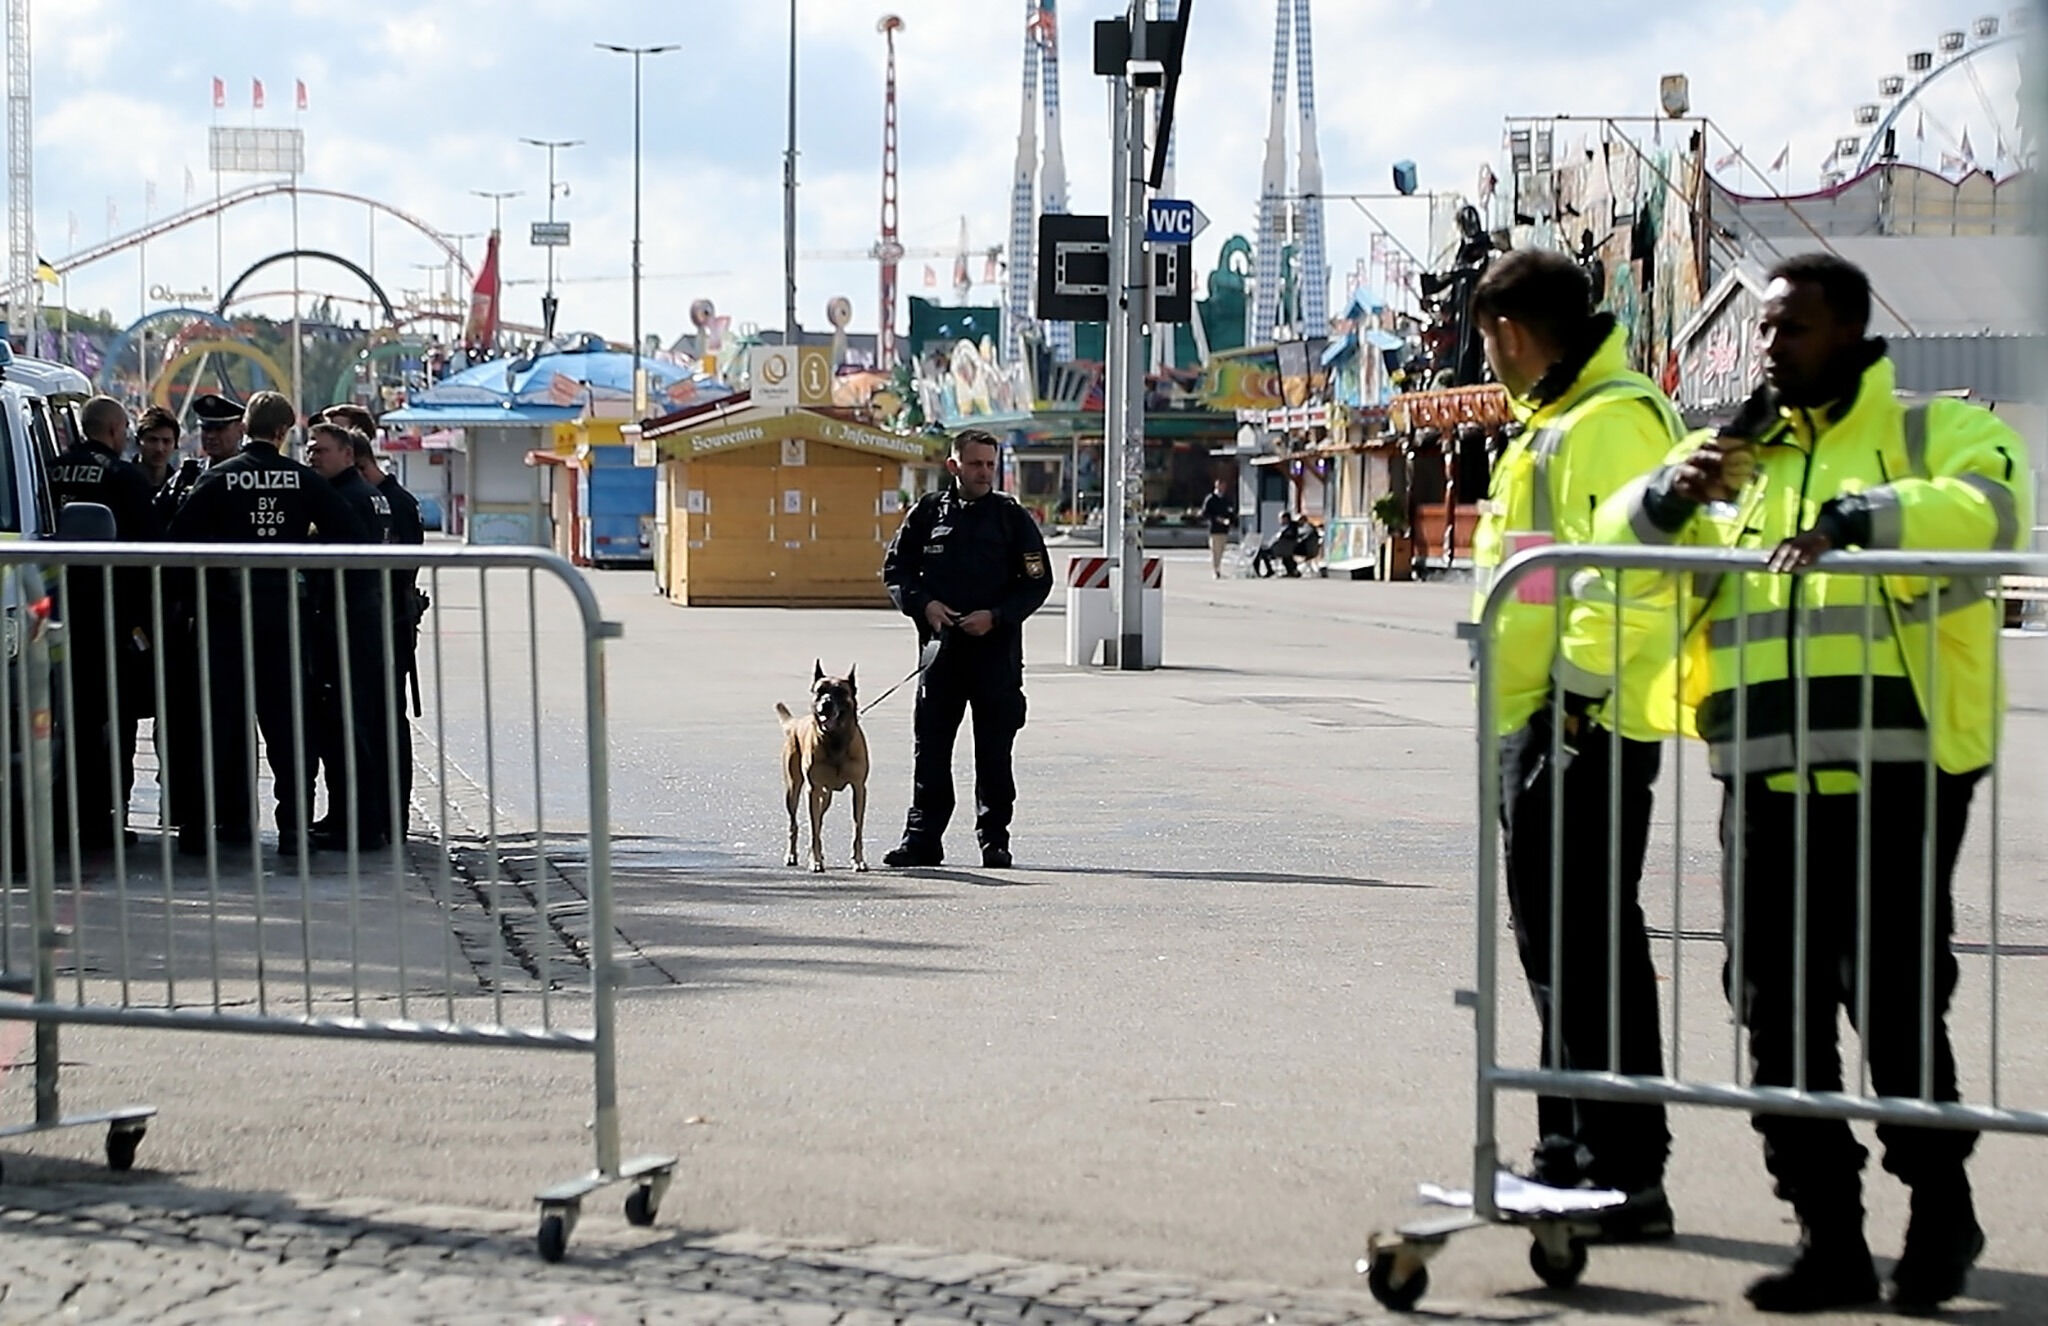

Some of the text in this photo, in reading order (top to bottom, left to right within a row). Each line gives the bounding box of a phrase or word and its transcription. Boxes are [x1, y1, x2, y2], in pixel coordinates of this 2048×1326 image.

[1151, 208, 1191, 234] WC
[691, 427, 764, 452] Souvenirs
[839, 424, 923, 456] Information
[50, 464, 104, 483] OLIZEI
[225, 470, 300, 491] POLIZEI
[258, 496, 278, 510] BY
[249, 511, 286, 525] 1326
